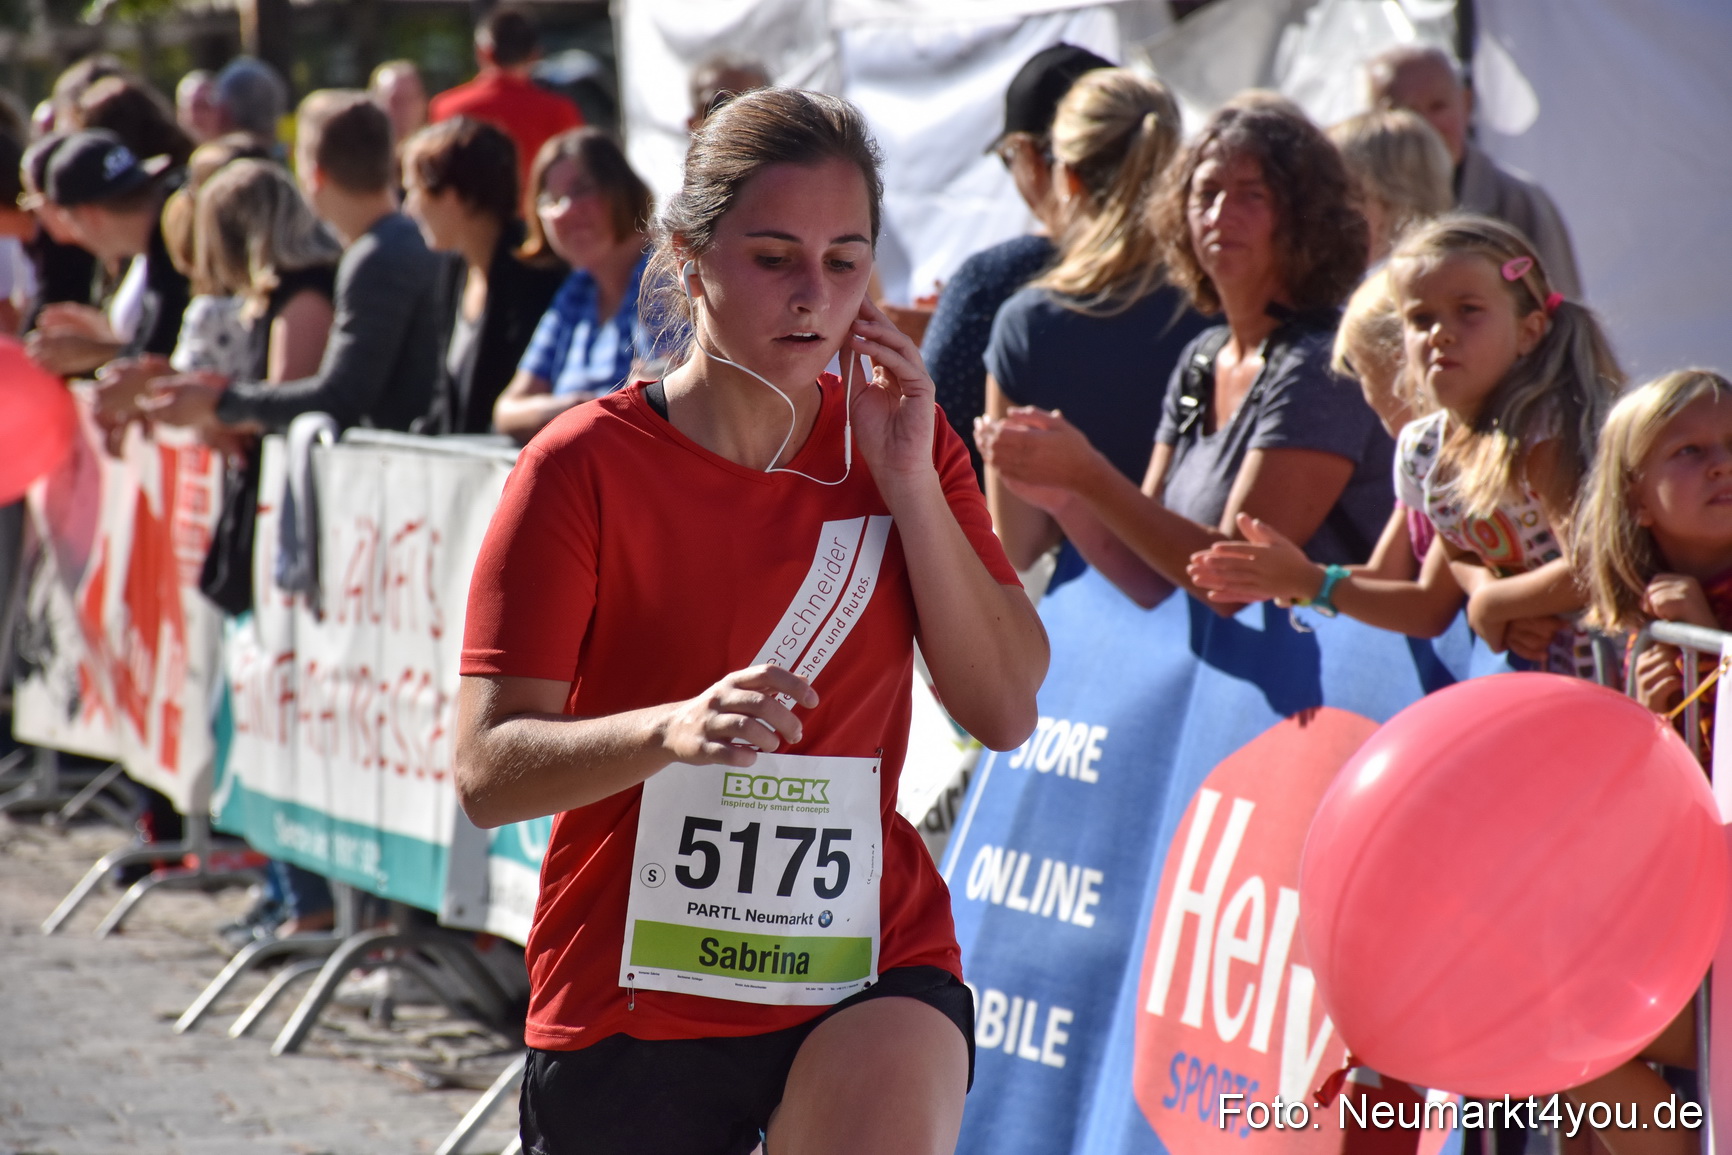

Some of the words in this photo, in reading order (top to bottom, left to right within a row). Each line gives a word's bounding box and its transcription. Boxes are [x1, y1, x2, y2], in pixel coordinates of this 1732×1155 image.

[825, 616, 847, 646] und
[842, 575, 871, 618] Autos.
[1008, 716, 1108, 784] STORE
[720, 798, 756, 809] inspired
[757, 801, 769, 812] by
[769, 804, 794, 812] smart
[795, 806, 830, 814] concepts
[722, 772, 830, 804] BOCK
[647, 869, 658, 883] S
[674, 816, 853, 900] 5175
[965, 844, 1104, 928] ONLINE
[686, 902, 742, 921] PARTL
[745, 909, 814, 926] Neumarkt
[698, 936, 811, 976] Sabrina
[1162, 1051, 1260, 1140] SPORTS
